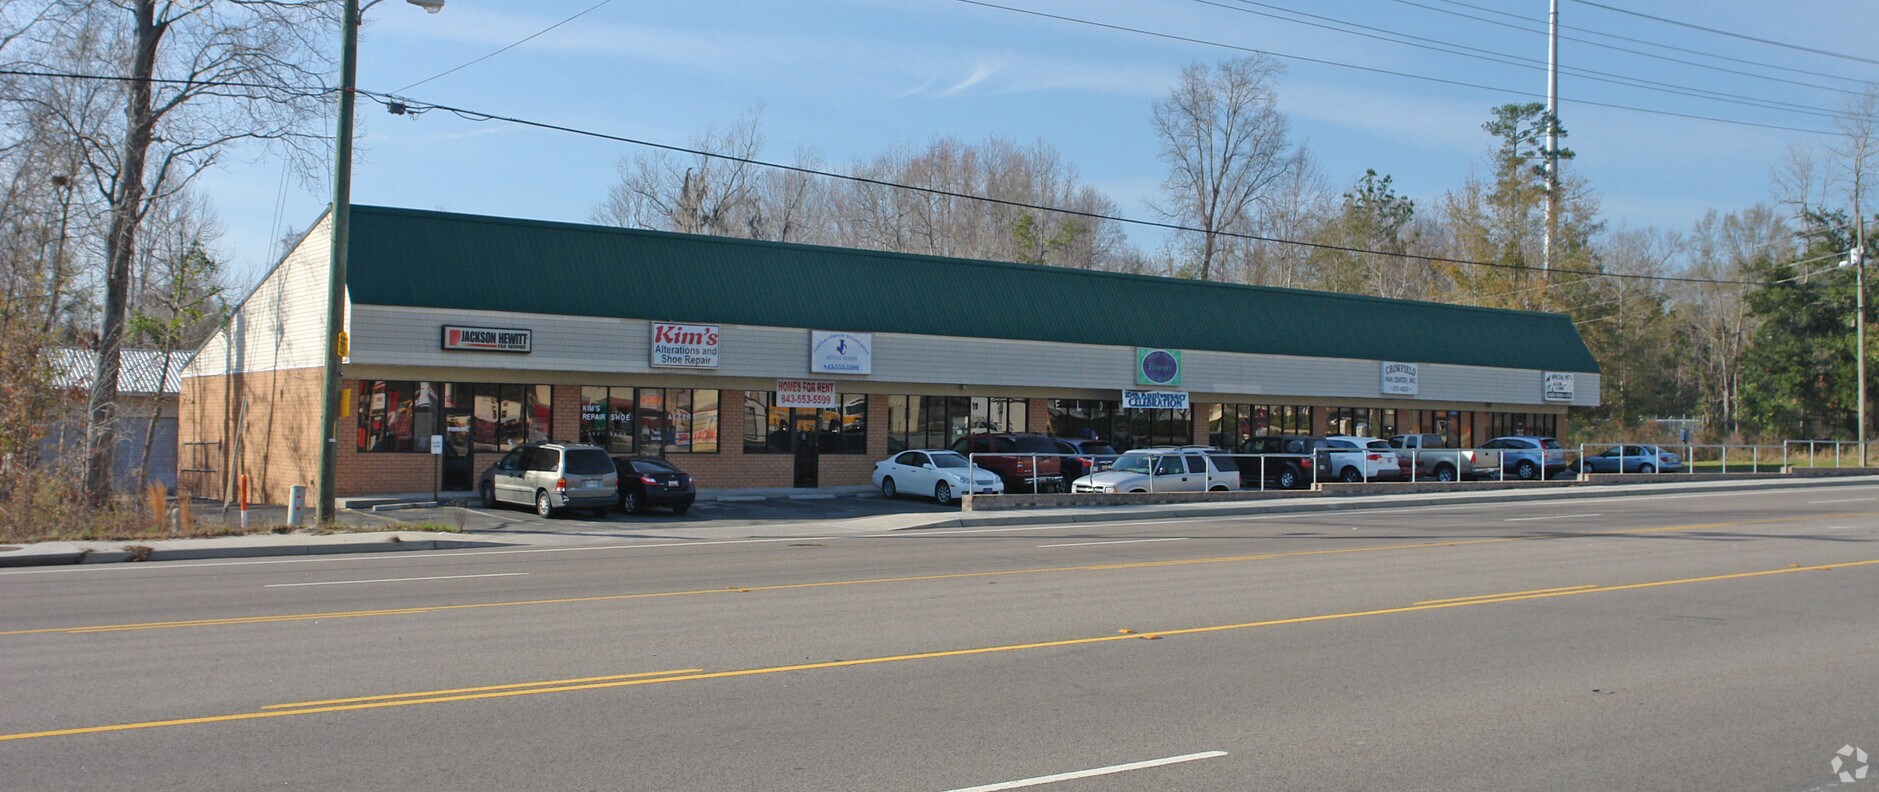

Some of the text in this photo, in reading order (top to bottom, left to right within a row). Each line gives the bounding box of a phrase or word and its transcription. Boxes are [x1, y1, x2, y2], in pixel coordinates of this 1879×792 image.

[461, 330, 528, 345] JACKSON HEWITT
[655, 325, 719, 346] Kim's
[655, 345, 717, 356] Alterations and
[661, 354, 711, 366] Shoe Repair
[778, 381, 834, 393] HOMES FOR RENT
[781, 394, 831, 405] 843-553-5599
[1141, 391, 1186, 401] Anniversary
[1129, 398, 1183, 408] CELEBRATION
[582, 413, 631, 421] REPAIR SHOE
